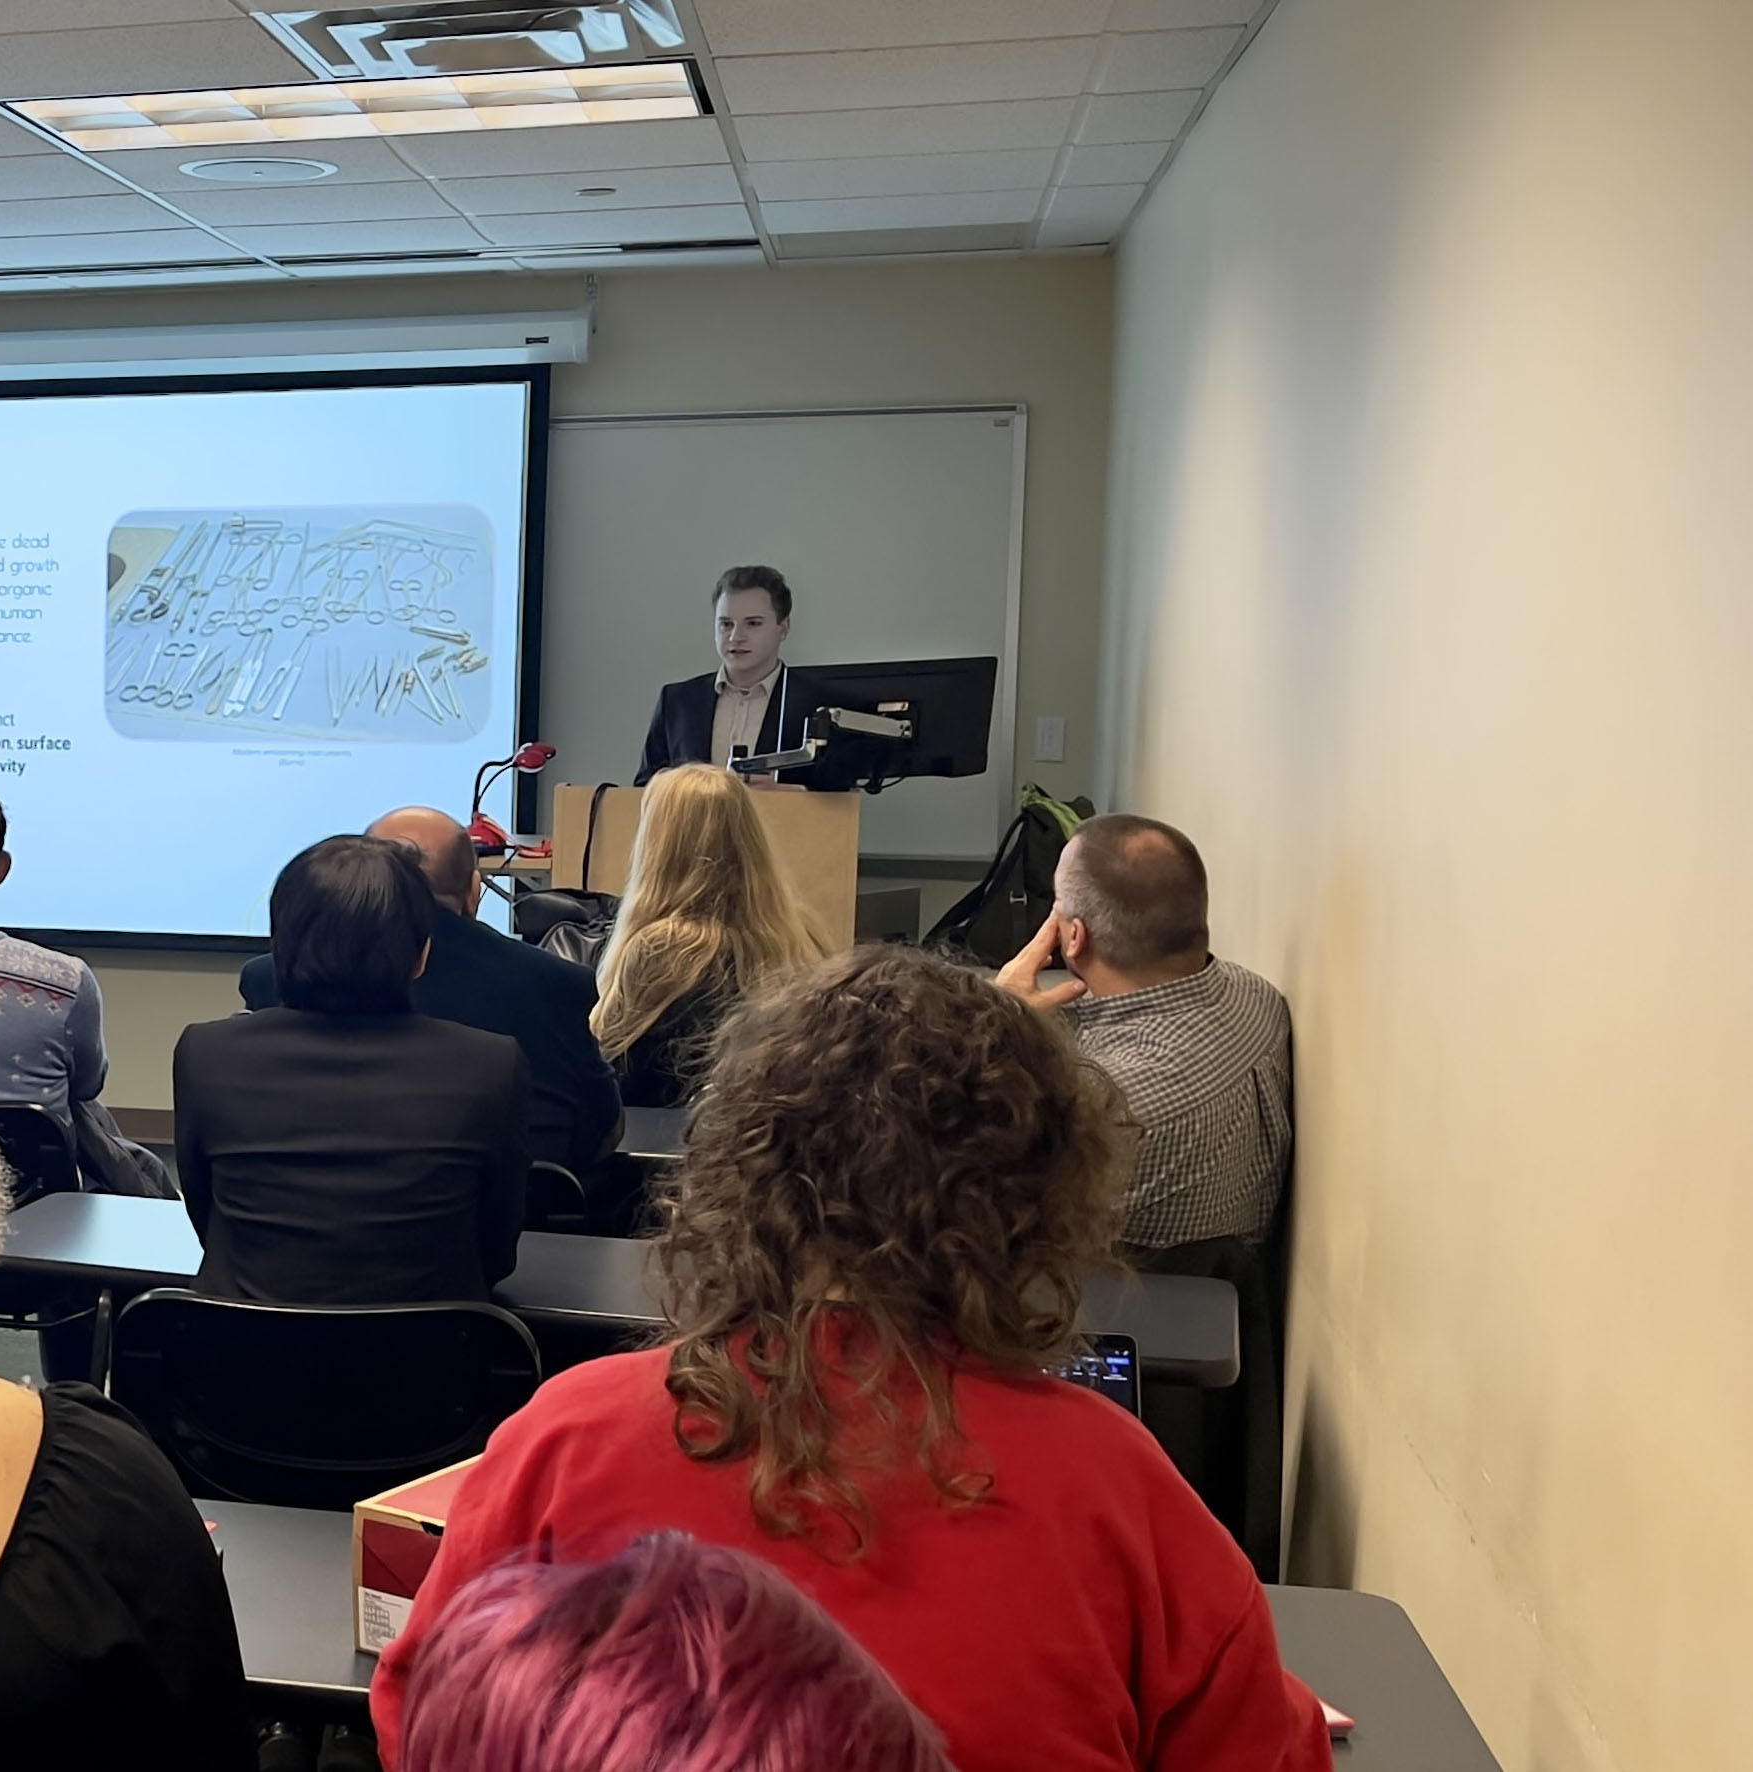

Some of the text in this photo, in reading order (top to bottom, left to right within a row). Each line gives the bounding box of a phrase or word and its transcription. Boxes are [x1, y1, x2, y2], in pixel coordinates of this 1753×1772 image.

[11, 531, 50, 550] dead
[10, 558, 60, 577] growth
[16, 734, 72, 750] surface
